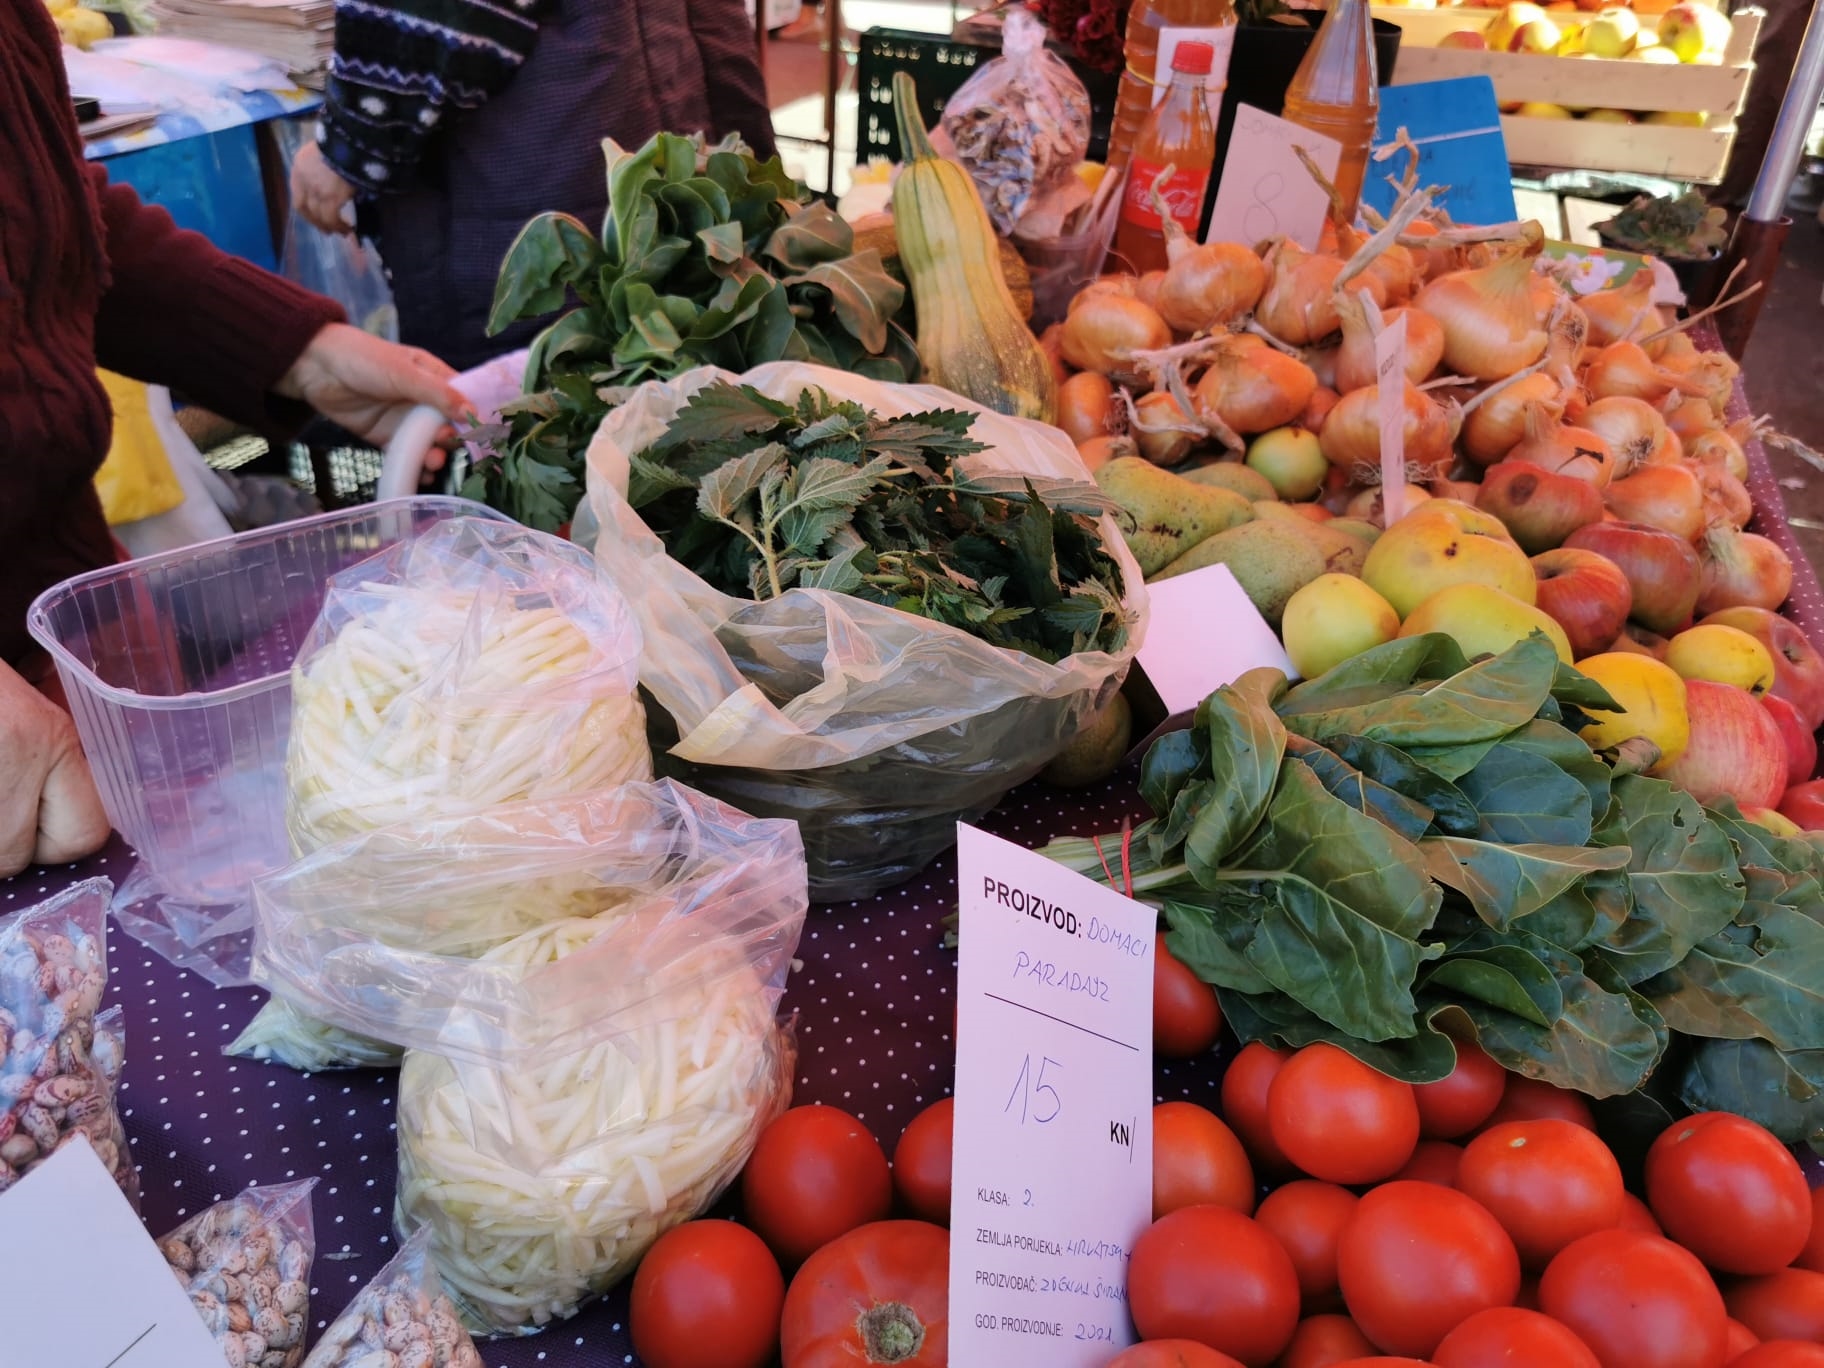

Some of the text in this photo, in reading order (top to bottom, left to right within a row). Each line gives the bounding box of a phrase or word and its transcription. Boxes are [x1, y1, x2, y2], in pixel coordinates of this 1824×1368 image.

[983, 875, 1082, 939] PROIZVOD:
[1004, 1052, 1063, 1125] 15
[977, 1187, 1010, 1207] KLASA:
[976, 1228, 1012, 1247] ZEMLJA
[1014, 1235, 1063, 1257] PORIJEKLA:
[975, 1270, 1038, 1293] PROIZVOĐAČ:
[975, 1313, 999, 1330] GOD.
[1001, 1316, 1064, 1337] PROIZVODNJE:
